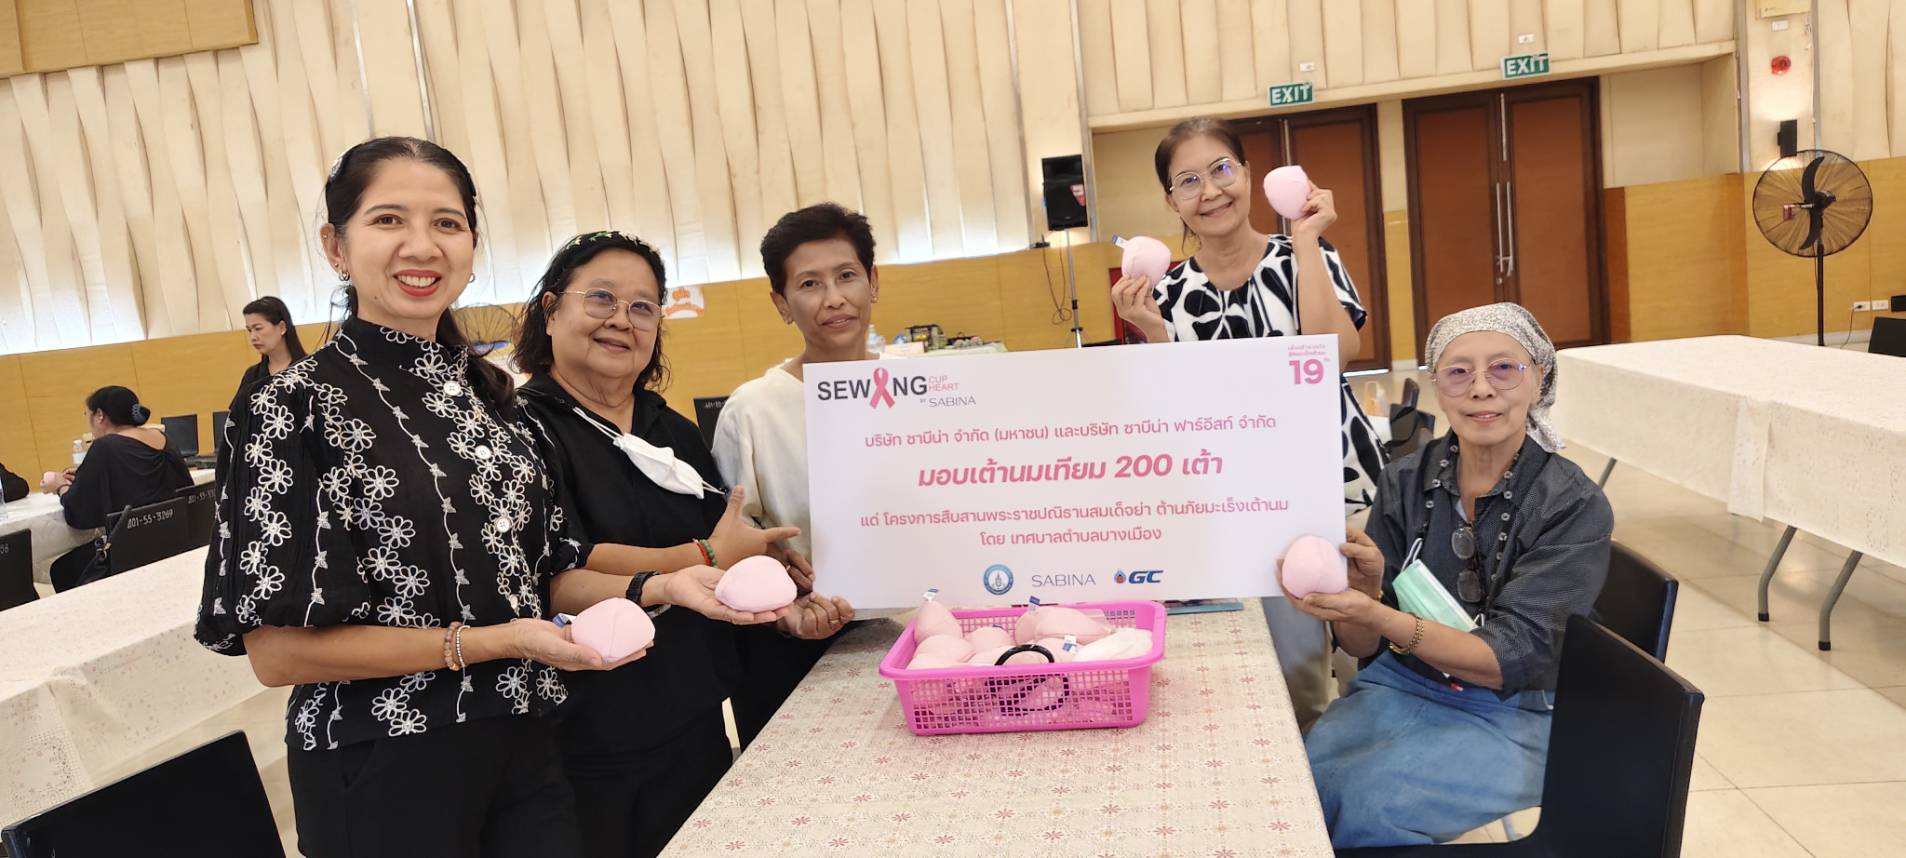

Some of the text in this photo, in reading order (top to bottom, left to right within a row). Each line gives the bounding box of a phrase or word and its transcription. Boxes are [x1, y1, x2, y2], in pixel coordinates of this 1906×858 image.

[1506, 56, 1547, 76] EXIT
[1271, 84, 1310, 104] EXIT
[928, 375, 948, 384] CUP
[1289, 358, 1324, 385] 19
[928, 382, 959, 392] HEART
[929, 395, 977, 408] SABINA
[865, 414, 1277, 448] บริษัท ซาบีน่า จำกัด (มหาชน) และบริษัท ซาบีน่า ฟาร์อีสท์ จำกัด
[918, 448, 1223, 487] มอบเต้านมเทียม 200 เต้า
[861, 512, 880, 527] แด่
[1156, 496, 1289, 517] ต้านภัยมะเร็งเต้านม
[980, 526, 1162, 546] โดย เทศบาลตำบลบางเมือง
[1031, 573, 1096, 588] SABINA
[1128, 570, 1164, 584] GC
